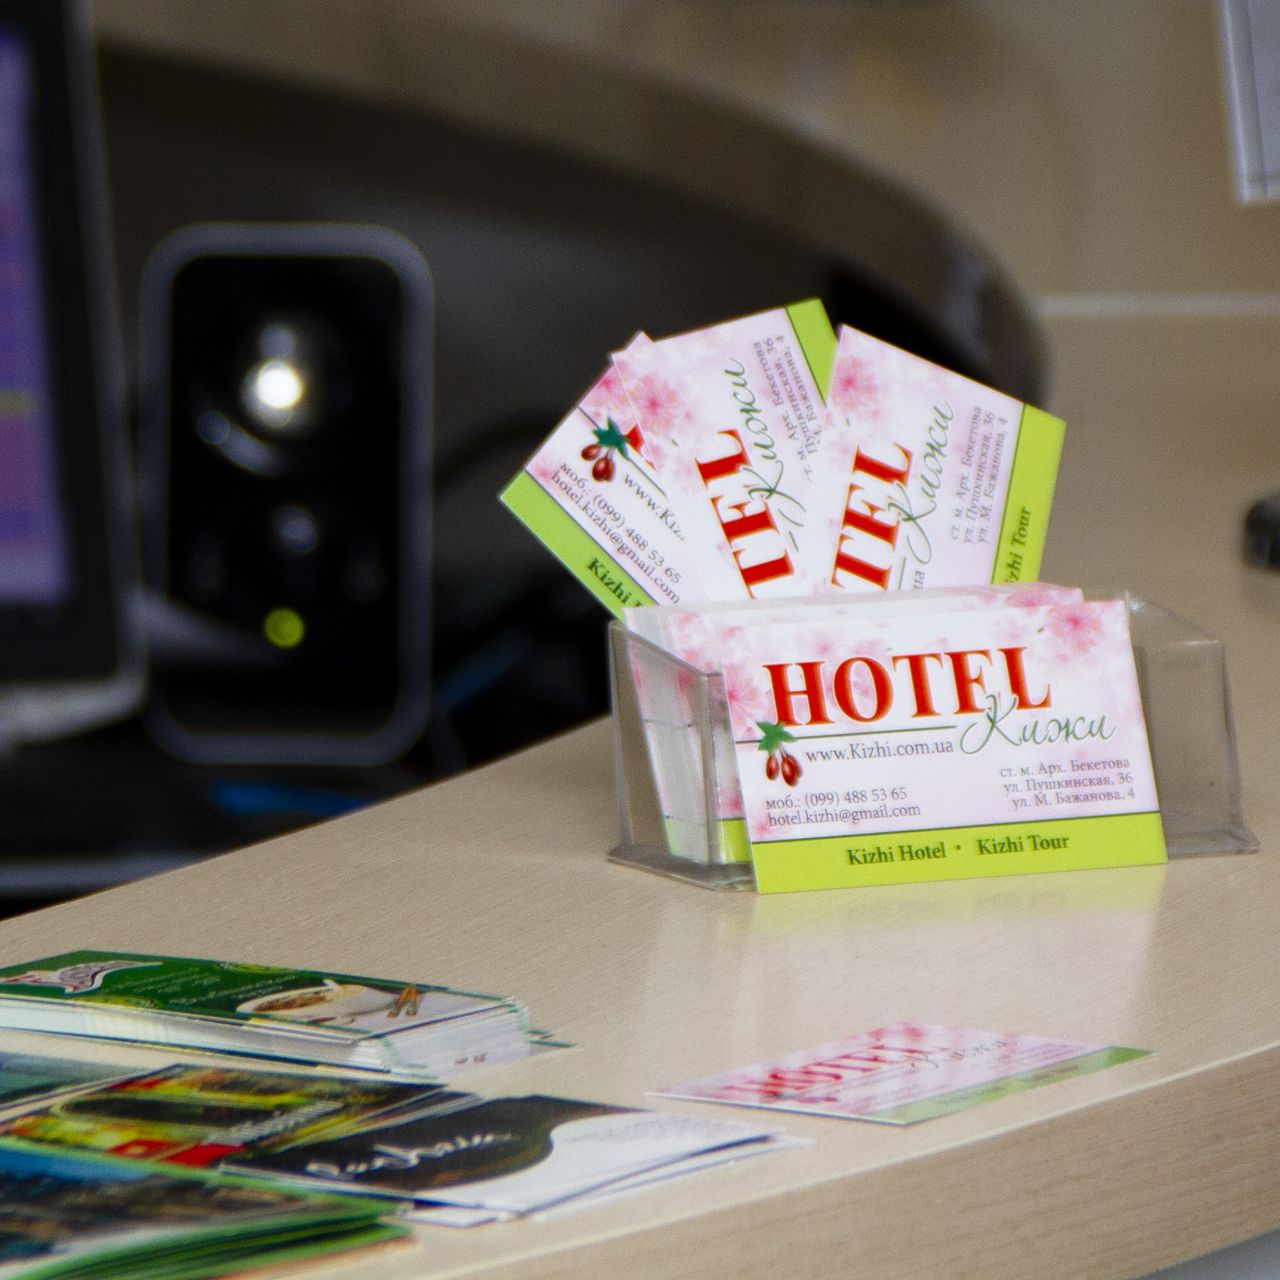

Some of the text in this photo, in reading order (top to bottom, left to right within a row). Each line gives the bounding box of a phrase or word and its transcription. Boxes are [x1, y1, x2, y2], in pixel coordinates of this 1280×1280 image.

[961, 406, 982, 468] Бекетова
[551, 470, 680, 605] hotel.kizhi@gmail.com
[1012, 506, 1033, 547] Tour
[626, 527, 650, 551] 488
[648, 549, 665, 567] 53
[664, 565, 682, 584] 65
[587, 557, 631, 605] Kizhi
[762, 646, 1052, 727] HOTEL
[805, 740, 954, 763] www.Kizhi.com.ua
[1000, 766, 1017, 778] ст.
[1038, 762, 1067, 778] Арх.
[1070, 758, 1131, 772] Бекетова
[804, 790, 840, 809] (099)
[844, 789, 868, 803] 488
[871, 788, 888, 802] 53
[891, 786, 908, 800] 65
[1003, 782, 1023, 797] ул.
[1118, 772, 1134, 785] 36
[1012, 797, 1032, 812] ул.
[1034, 794, 1053, 807] М.
[1126, 788, 1136, 800] 4
[767, 804, 921, 827] hotel.kizhi@gmail.com
[846, 833, 1070, 865] Kizhi Hotel Kizhi Tour
